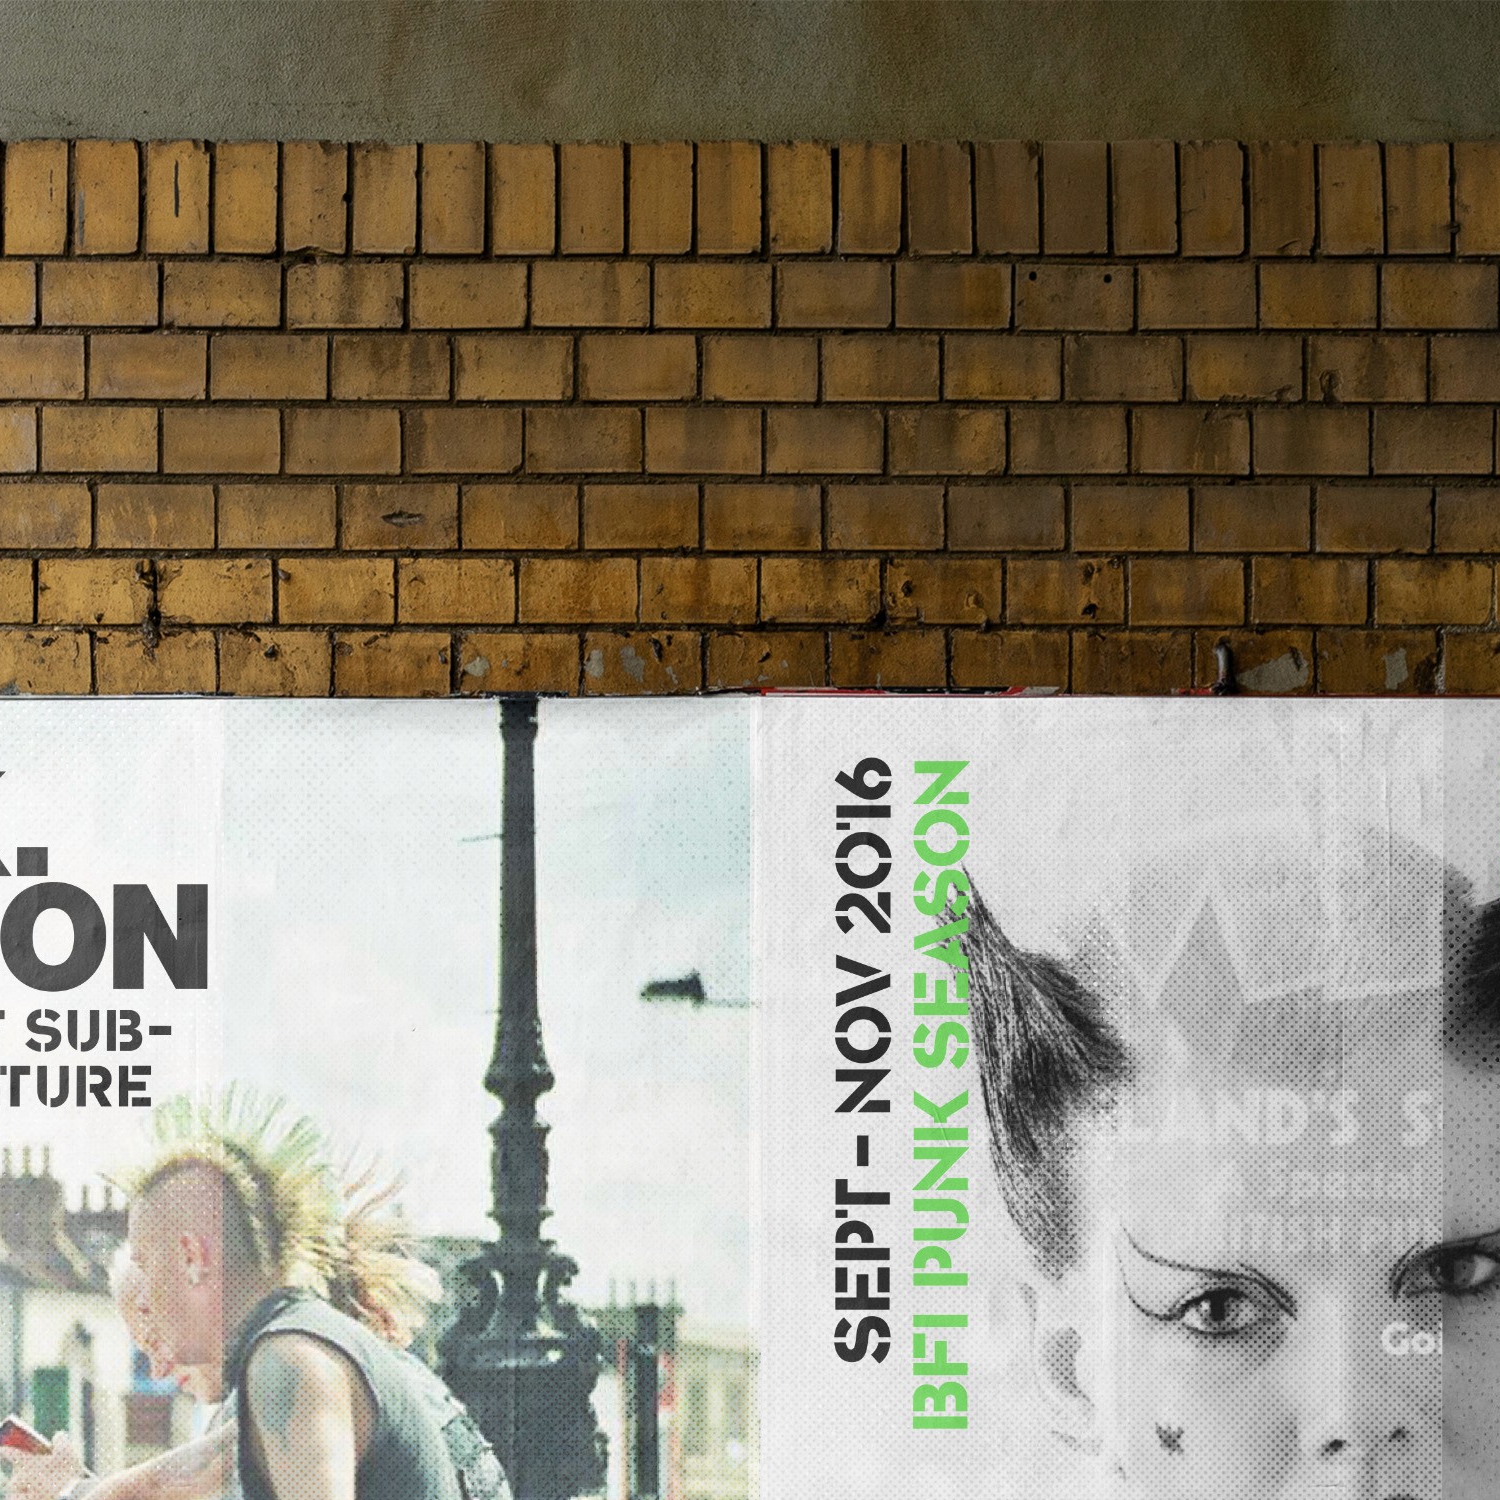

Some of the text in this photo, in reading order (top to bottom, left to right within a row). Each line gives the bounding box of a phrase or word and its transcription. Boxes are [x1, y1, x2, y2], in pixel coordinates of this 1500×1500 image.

[835, 756, 892, 934] 2016
[25, 1009, 172, 1053] SUB-
[835, 954, 892, 1113] NOV
[912, 760, 971, 1429] BFI PUNK SEASON
[835, 1178, 892, 1364] SEPT
